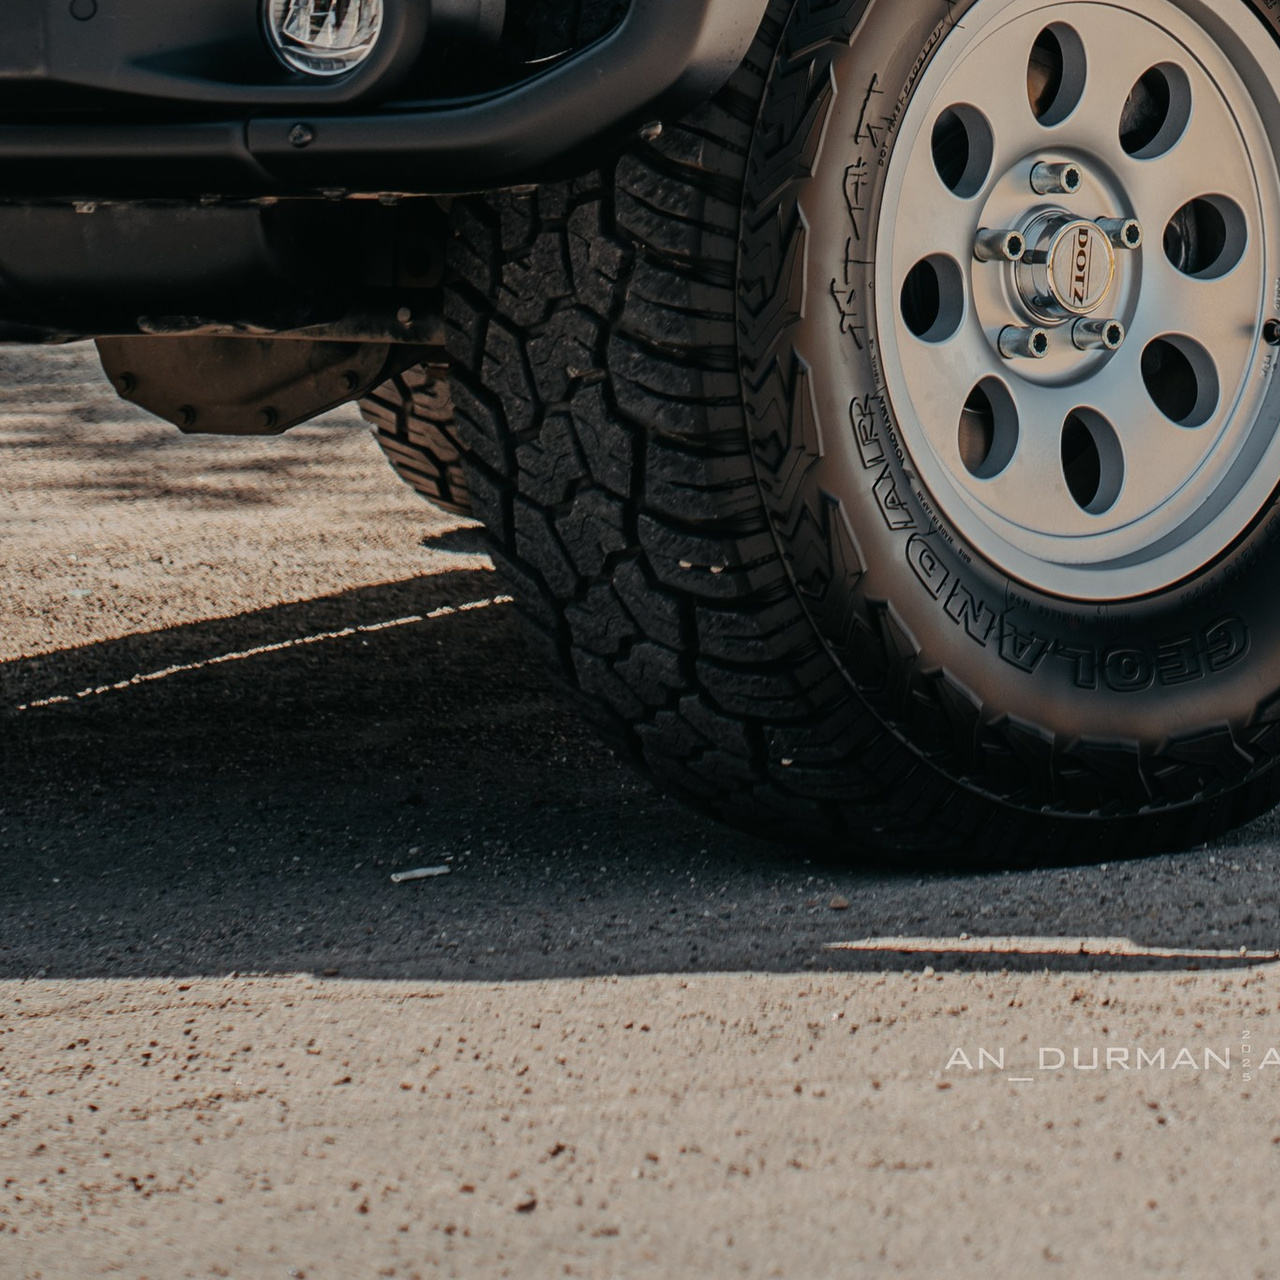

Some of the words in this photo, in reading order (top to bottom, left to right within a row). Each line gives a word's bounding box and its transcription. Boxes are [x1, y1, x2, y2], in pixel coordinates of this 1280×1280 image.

[1073, 228, 1089, 305] DOTZ
[878, 394, 906, 467] YOKOHAMA
[849, 393, 1251, 693] GEOLANDAR
